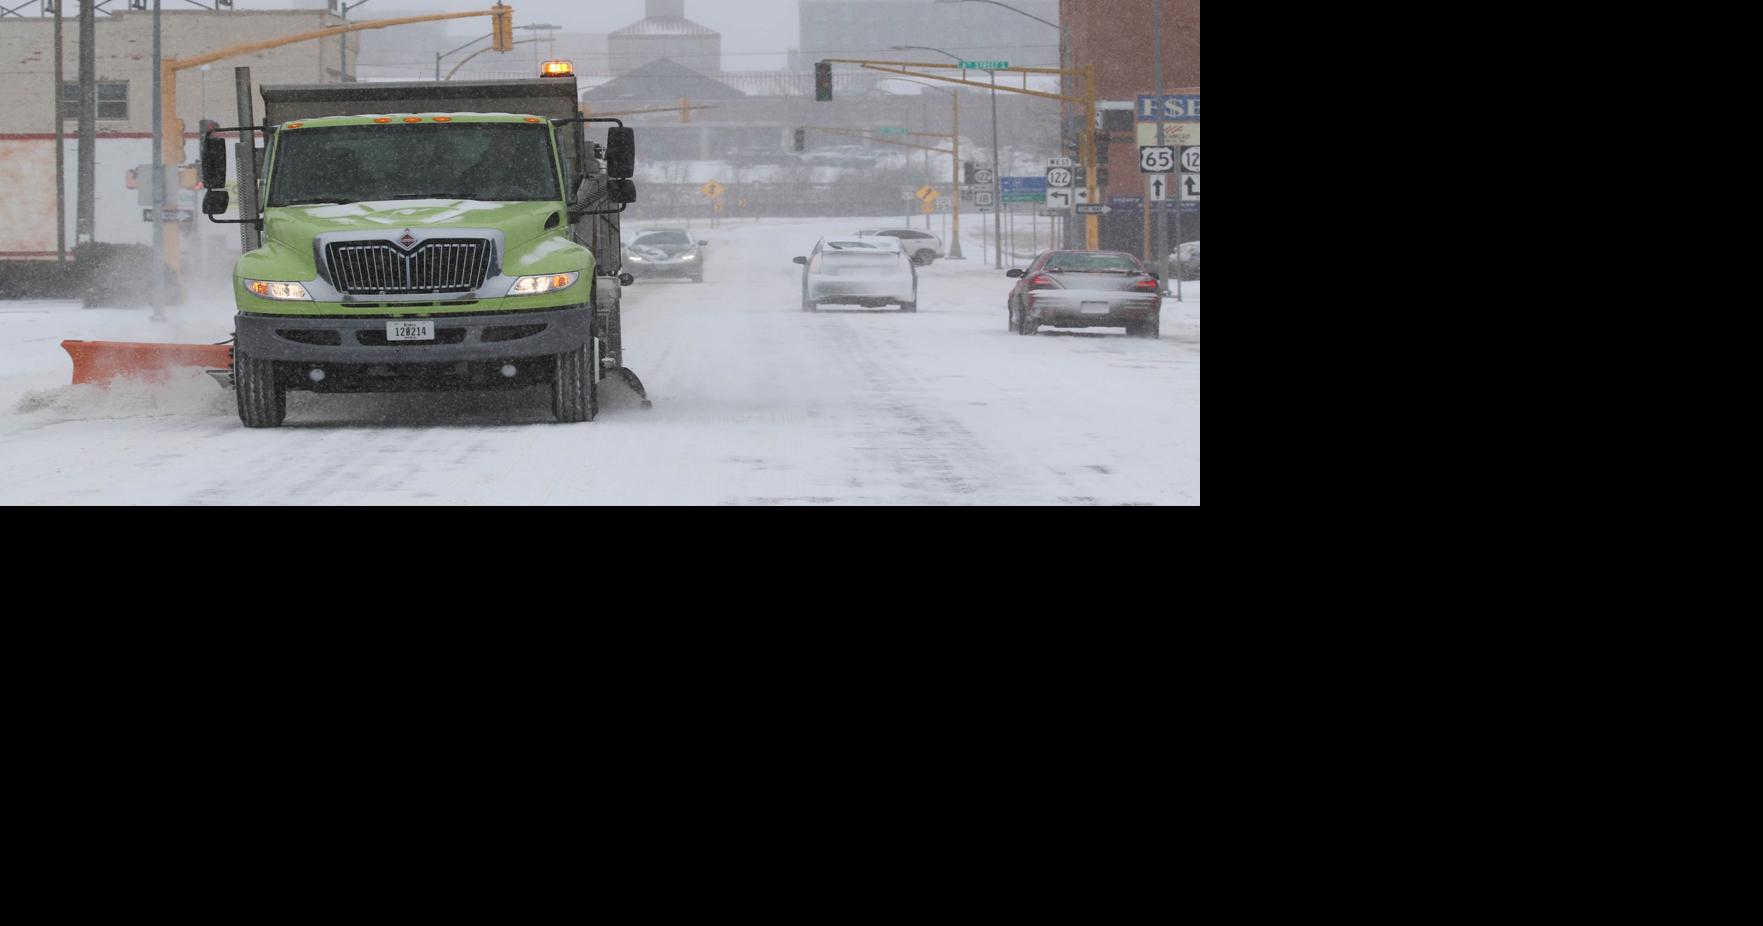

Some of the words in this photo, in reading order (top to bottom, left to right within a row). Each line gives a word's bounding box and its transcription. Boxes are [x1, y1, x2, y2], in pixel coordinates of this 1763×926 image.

[1146, 152, 1169, 167] 65
[1185, 152, 1200, 167] 12
[1050, 172, 1068, 183] 122
